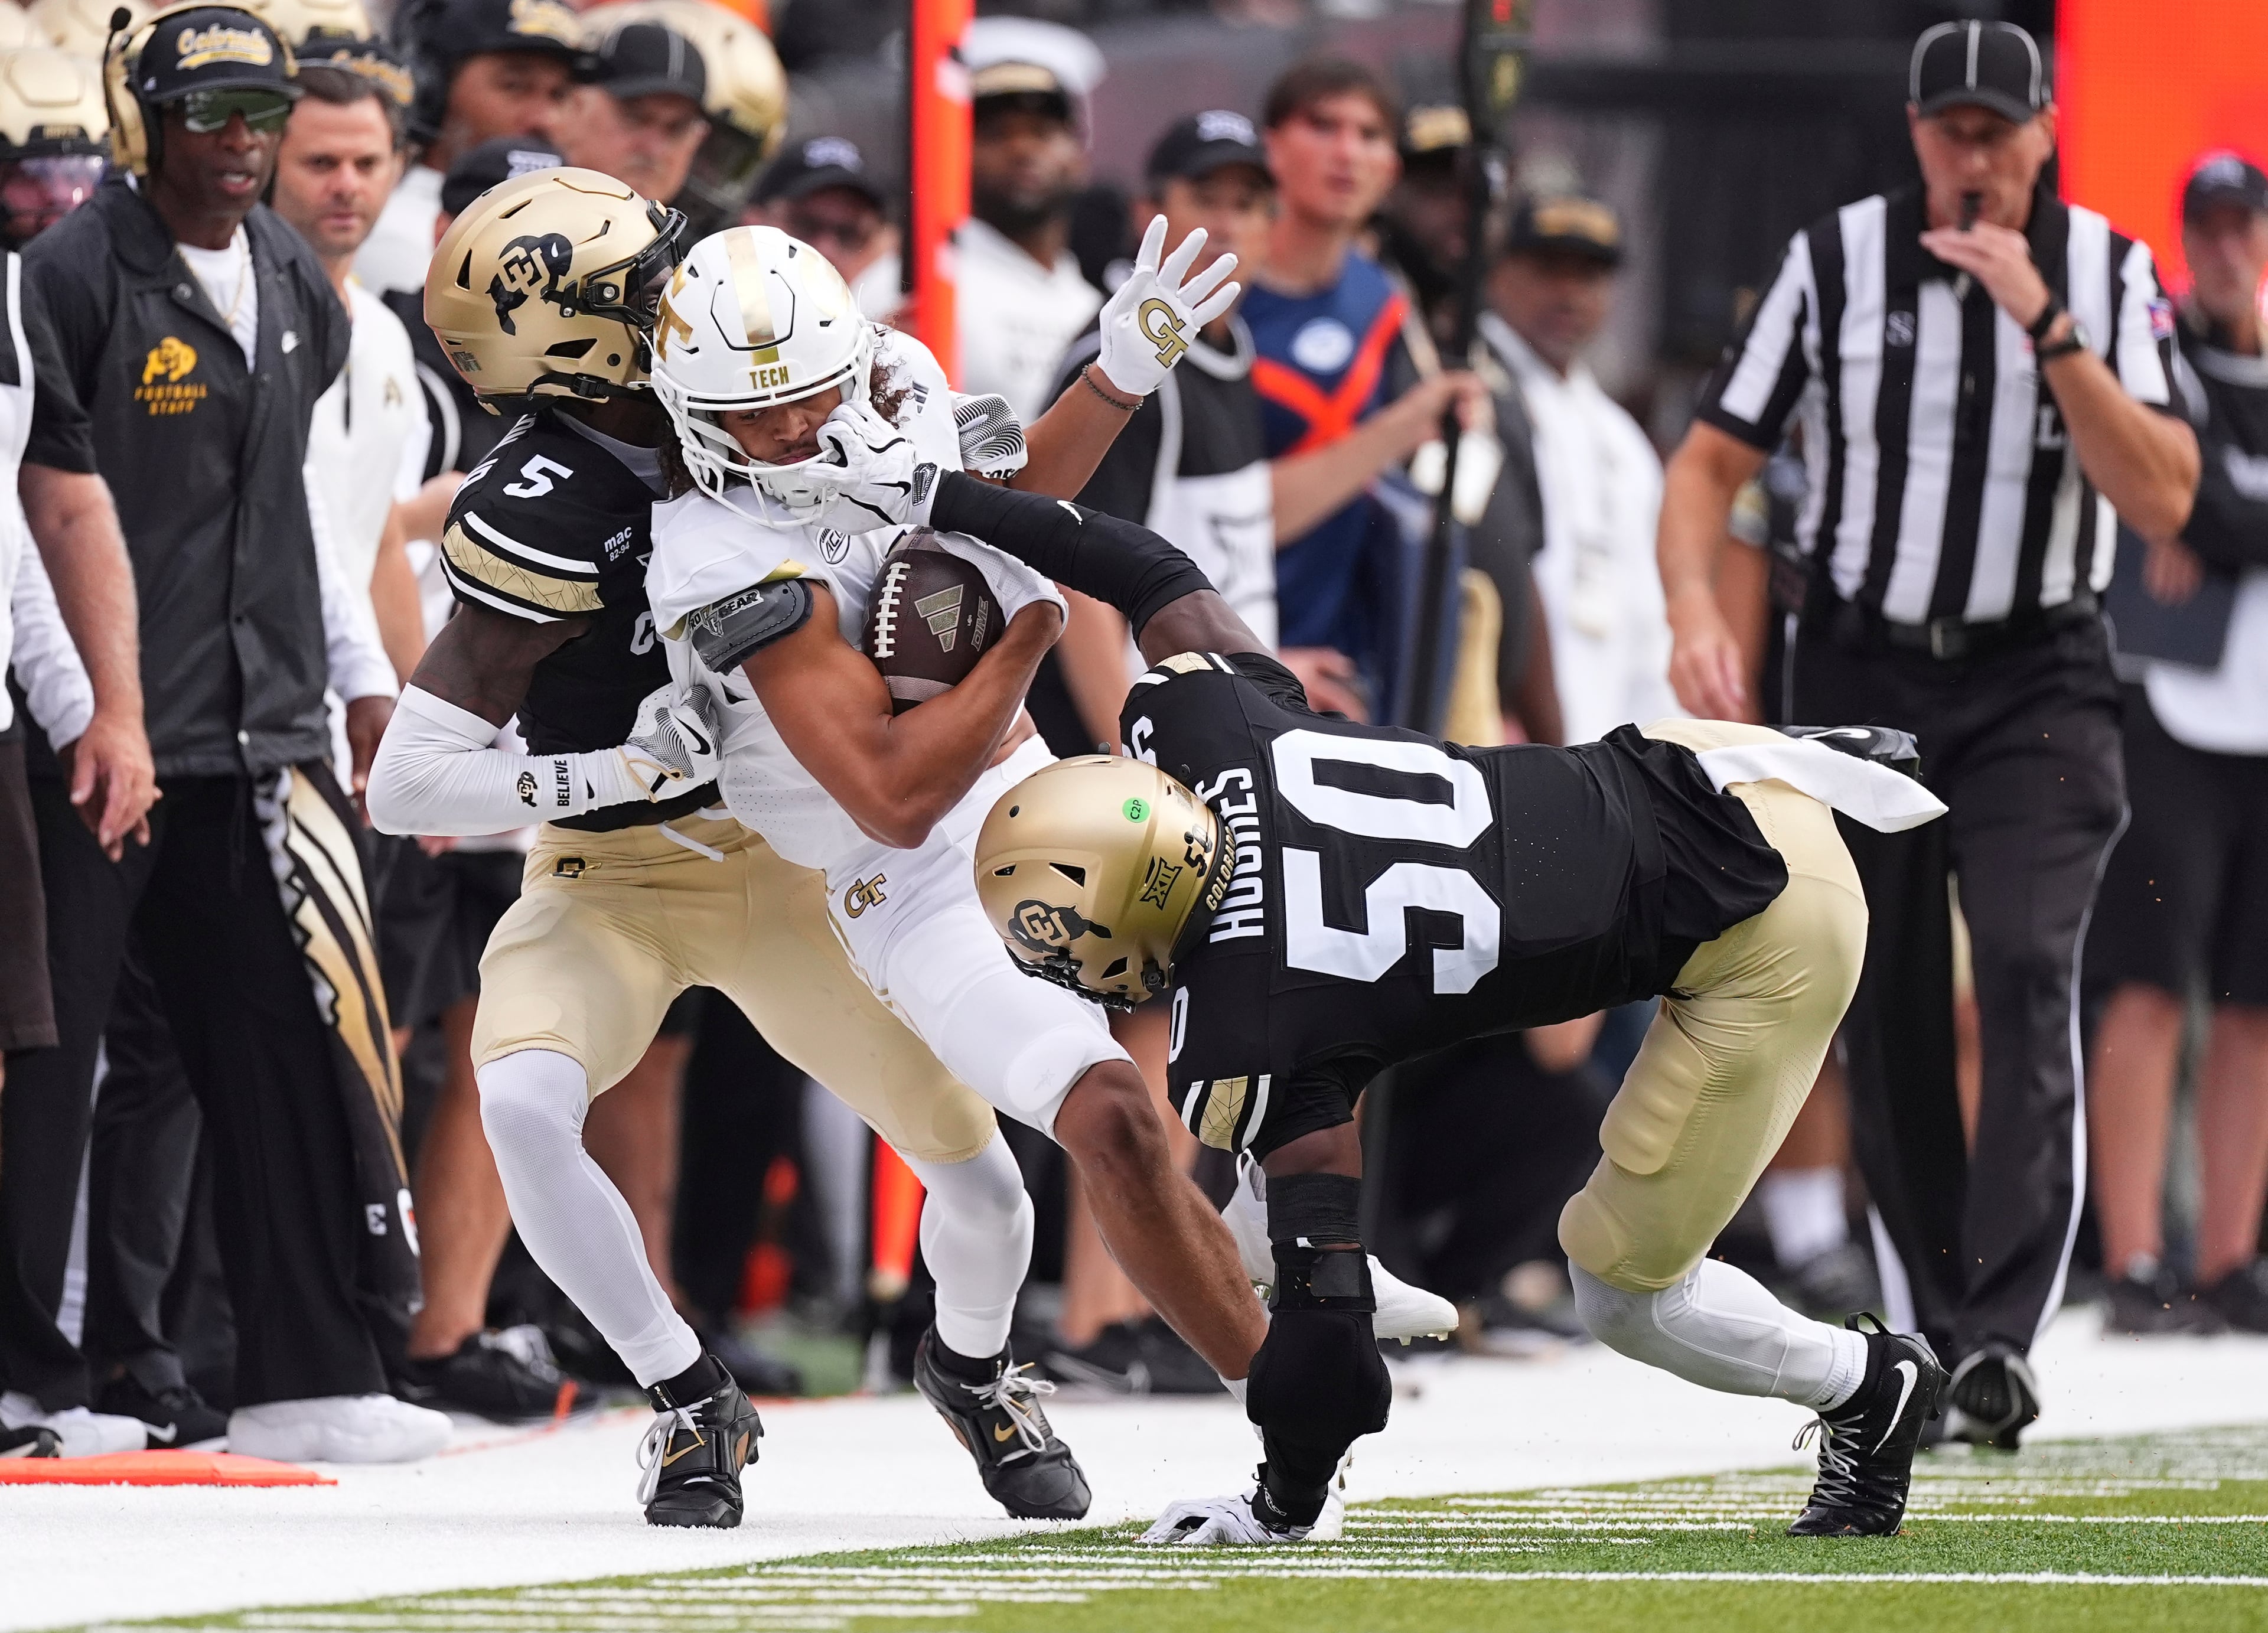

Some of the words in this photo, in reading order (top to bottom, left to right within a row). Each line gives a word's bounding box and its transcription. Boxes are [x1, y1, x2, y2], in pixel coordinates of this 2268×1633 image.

[749, 366, 789, 389] TECH
[503, 454, 574, 498] 5
[604, 526, 632, 552] mac
[610, 541, 630, 561] 82-94
[971, 595, 989, 652] DIME
[554, 760, 570, 807] BELIEVE
[1130, 800, 1142, 819] C2P
[1271, 729, 1501, 995] 50
[844, 873, 887, 919] GT
[654, 1386, 672, 1409] PRIME
